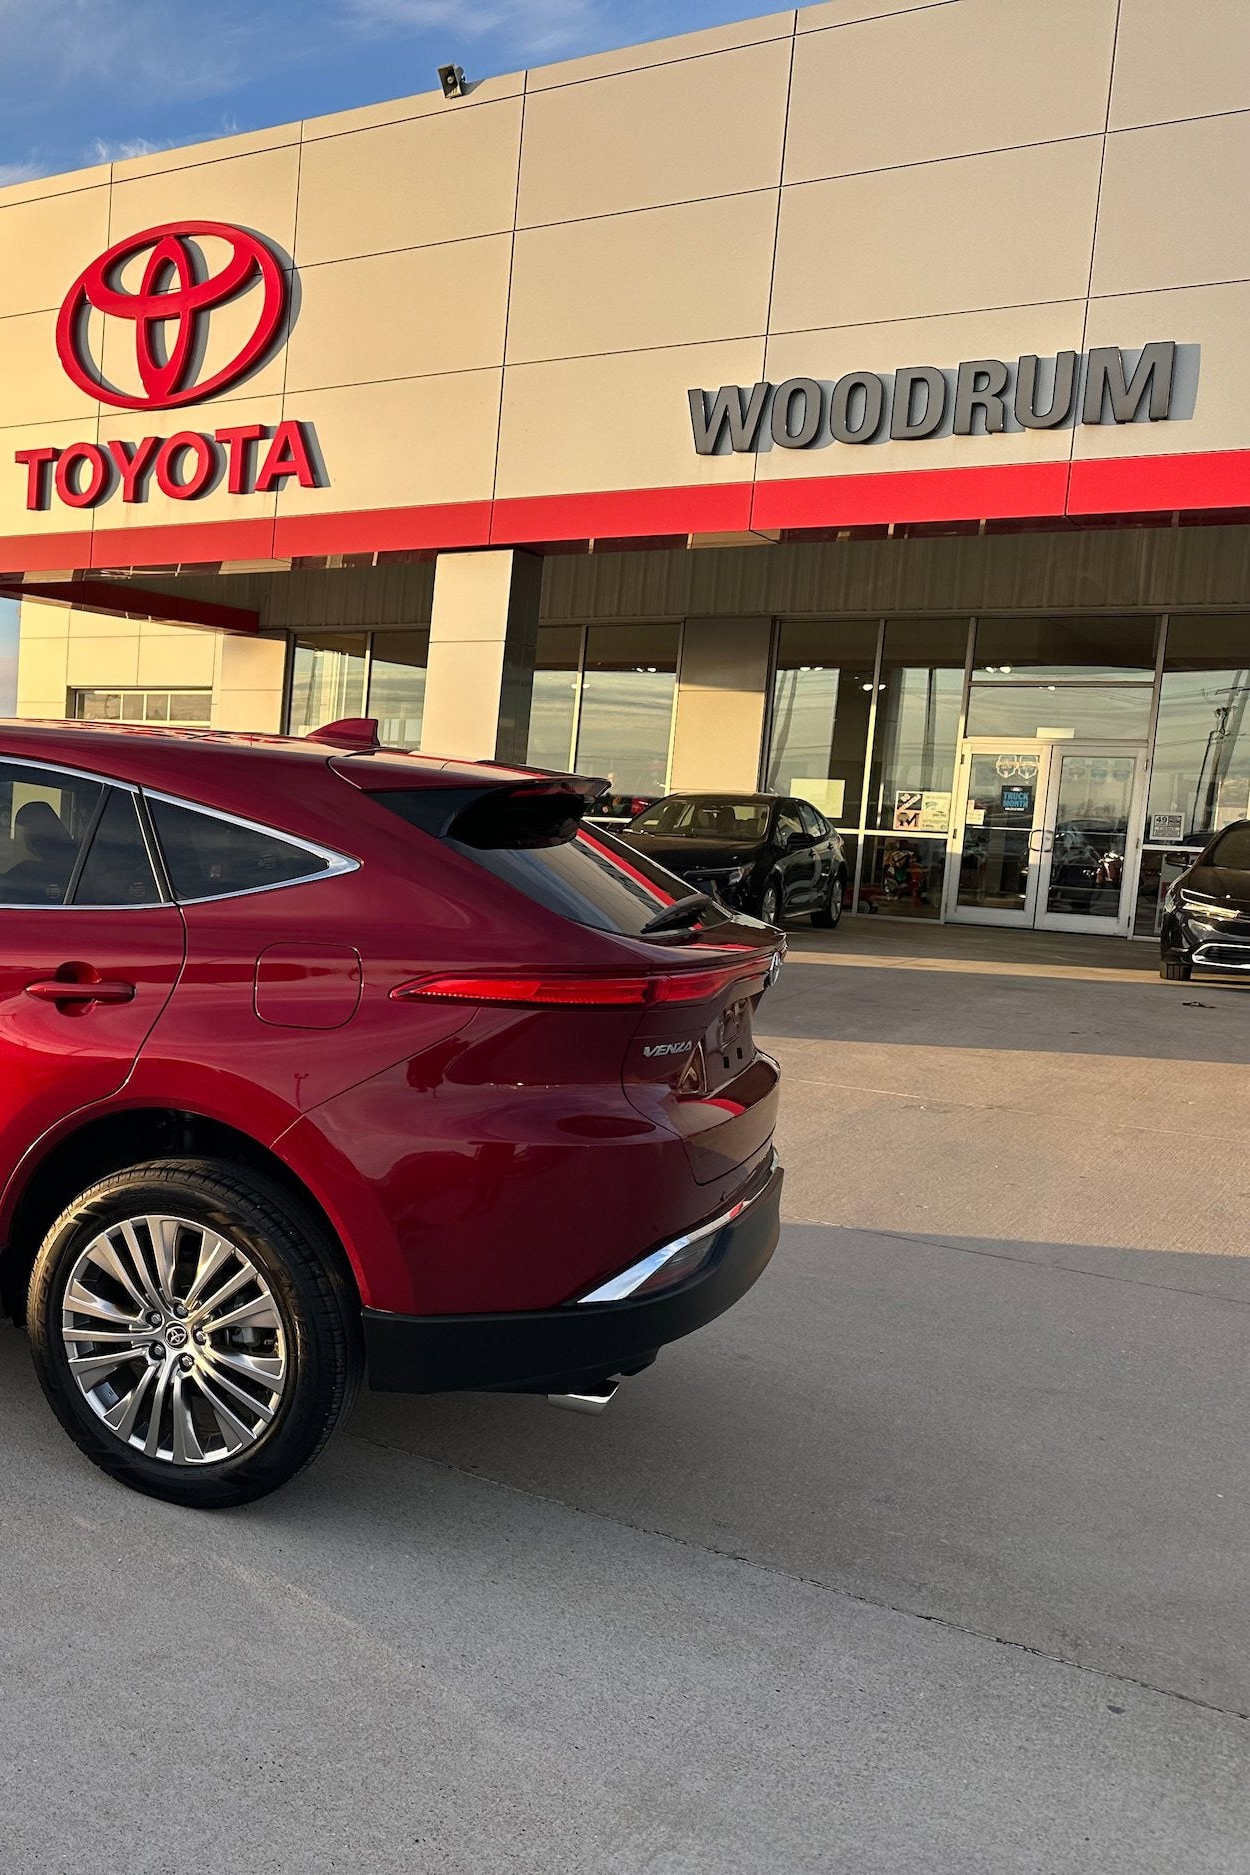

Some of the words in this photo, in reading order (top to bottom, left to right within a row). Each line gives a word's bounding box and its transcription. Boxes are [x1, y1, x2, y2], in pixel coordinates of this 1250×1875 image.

[687, 340, 1176, 455] WOODRUM
[15, 420, 321, 511] TOYOTA
[1002, 800, 1028, 808] MONTH
[1003, 792, 1029, 800] TRUCK
[643, 1040, 692, 1057] VENZA
